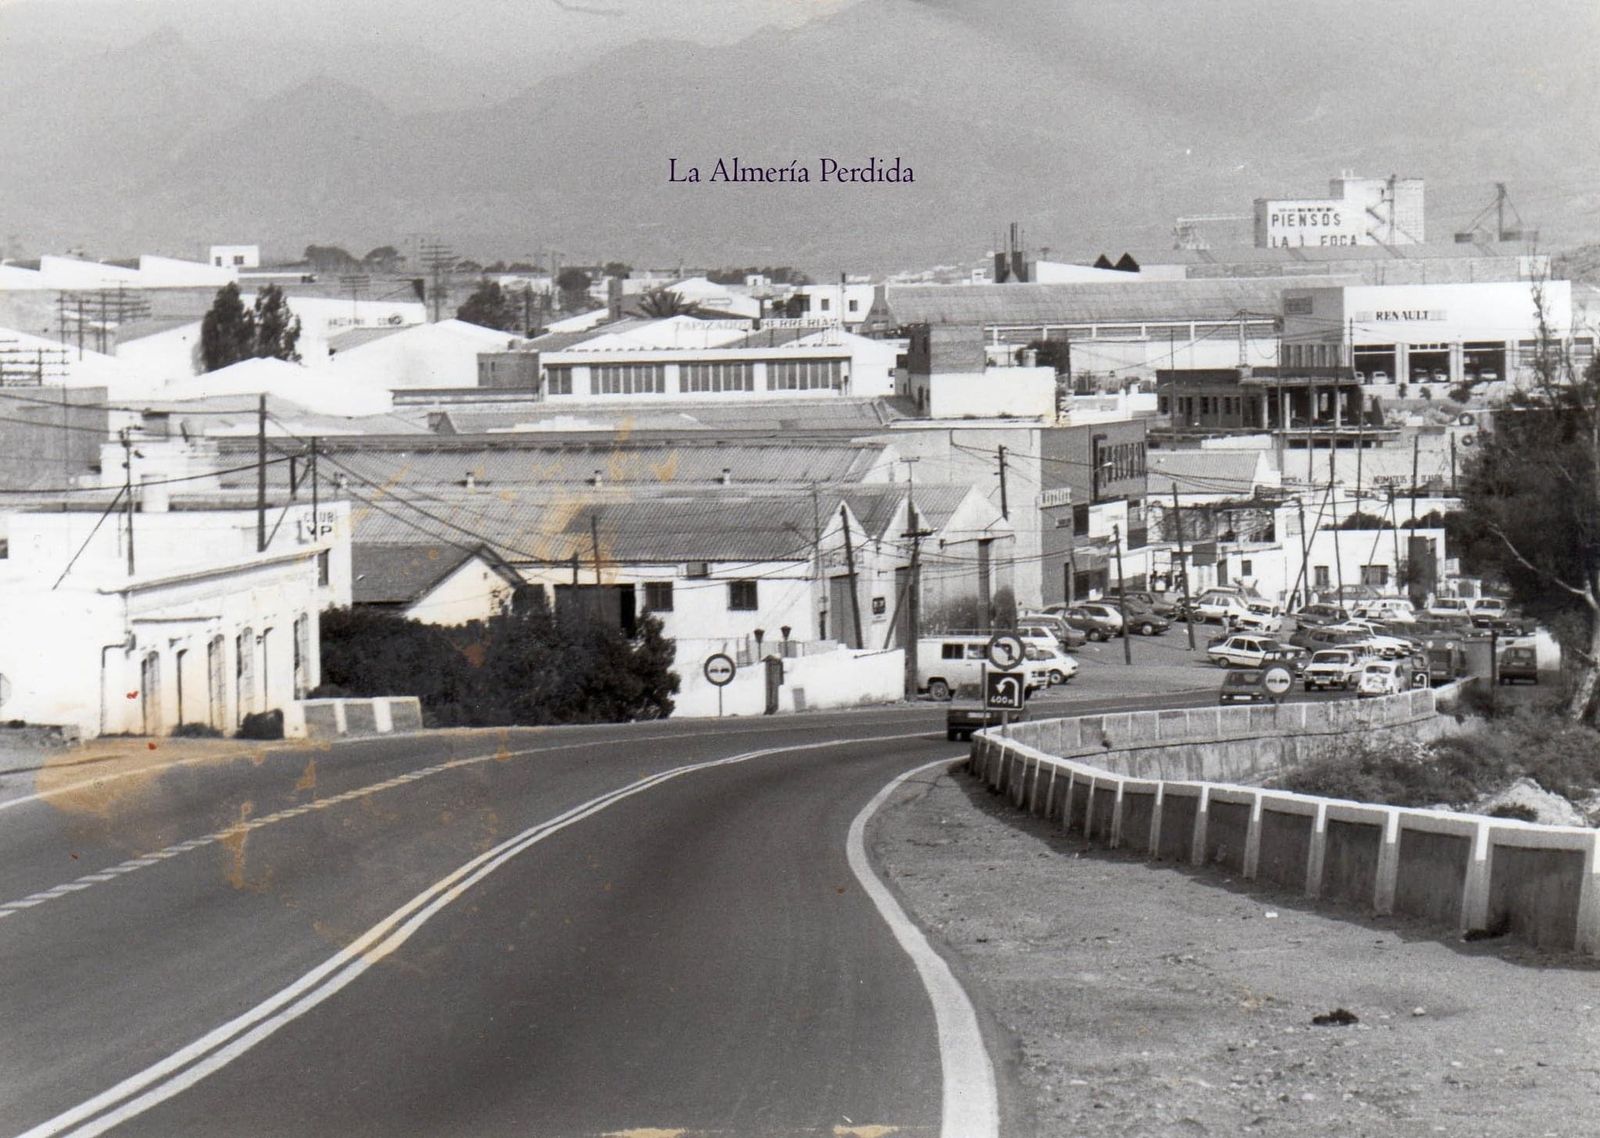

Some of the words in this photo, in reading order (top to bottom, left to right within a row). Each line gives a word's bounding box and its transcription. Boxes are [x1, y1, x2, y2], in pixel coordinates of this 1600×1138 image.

[1271, 213, 1342, 227] PIENSOS
[1272, 236, 1289, 248] LA
[1320, 235, 1358, 247] FOCA
[1376, 310, 1429, 321] RENAULT
